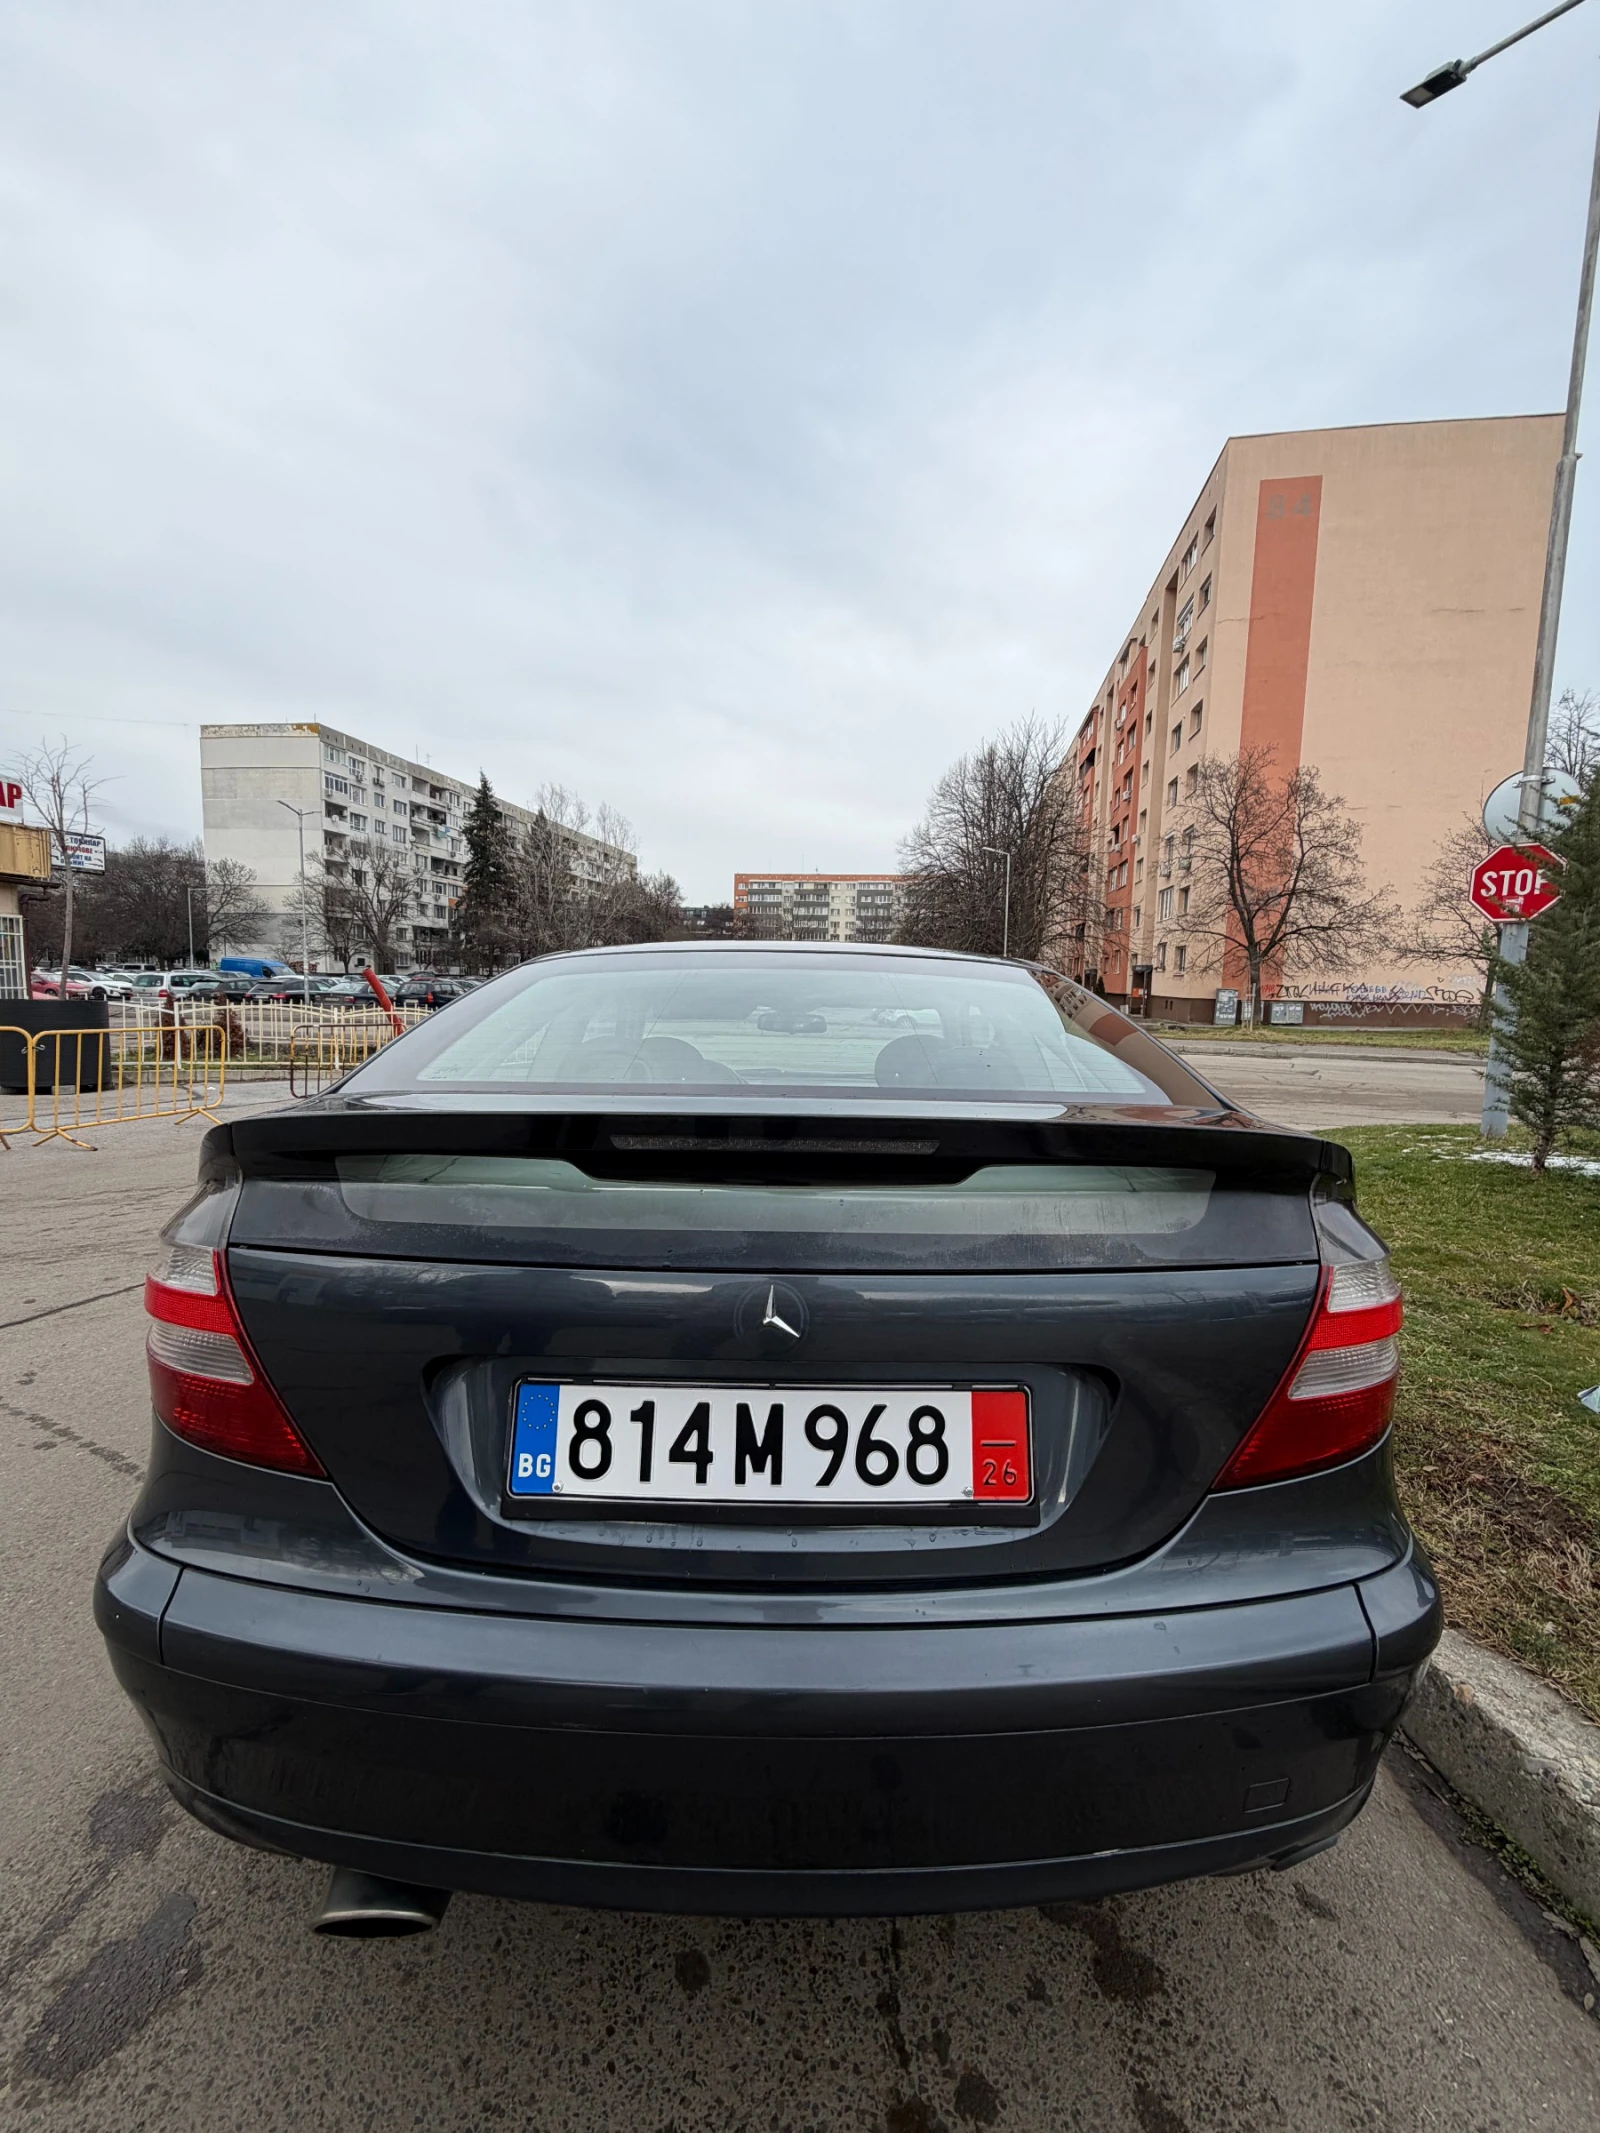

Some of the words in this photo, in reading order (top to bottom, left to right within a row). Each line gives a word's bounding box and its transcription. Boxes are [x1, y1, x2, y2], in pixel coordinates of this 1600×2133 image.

[1266, 492, 1311, 521] 84
[1480, 869, 1549, 897] STOP
[568, 1398, 949, 1486] 814M968
[517, 1453, 551, 1478] BG
[983, 1458, 1017, 1486] 26
